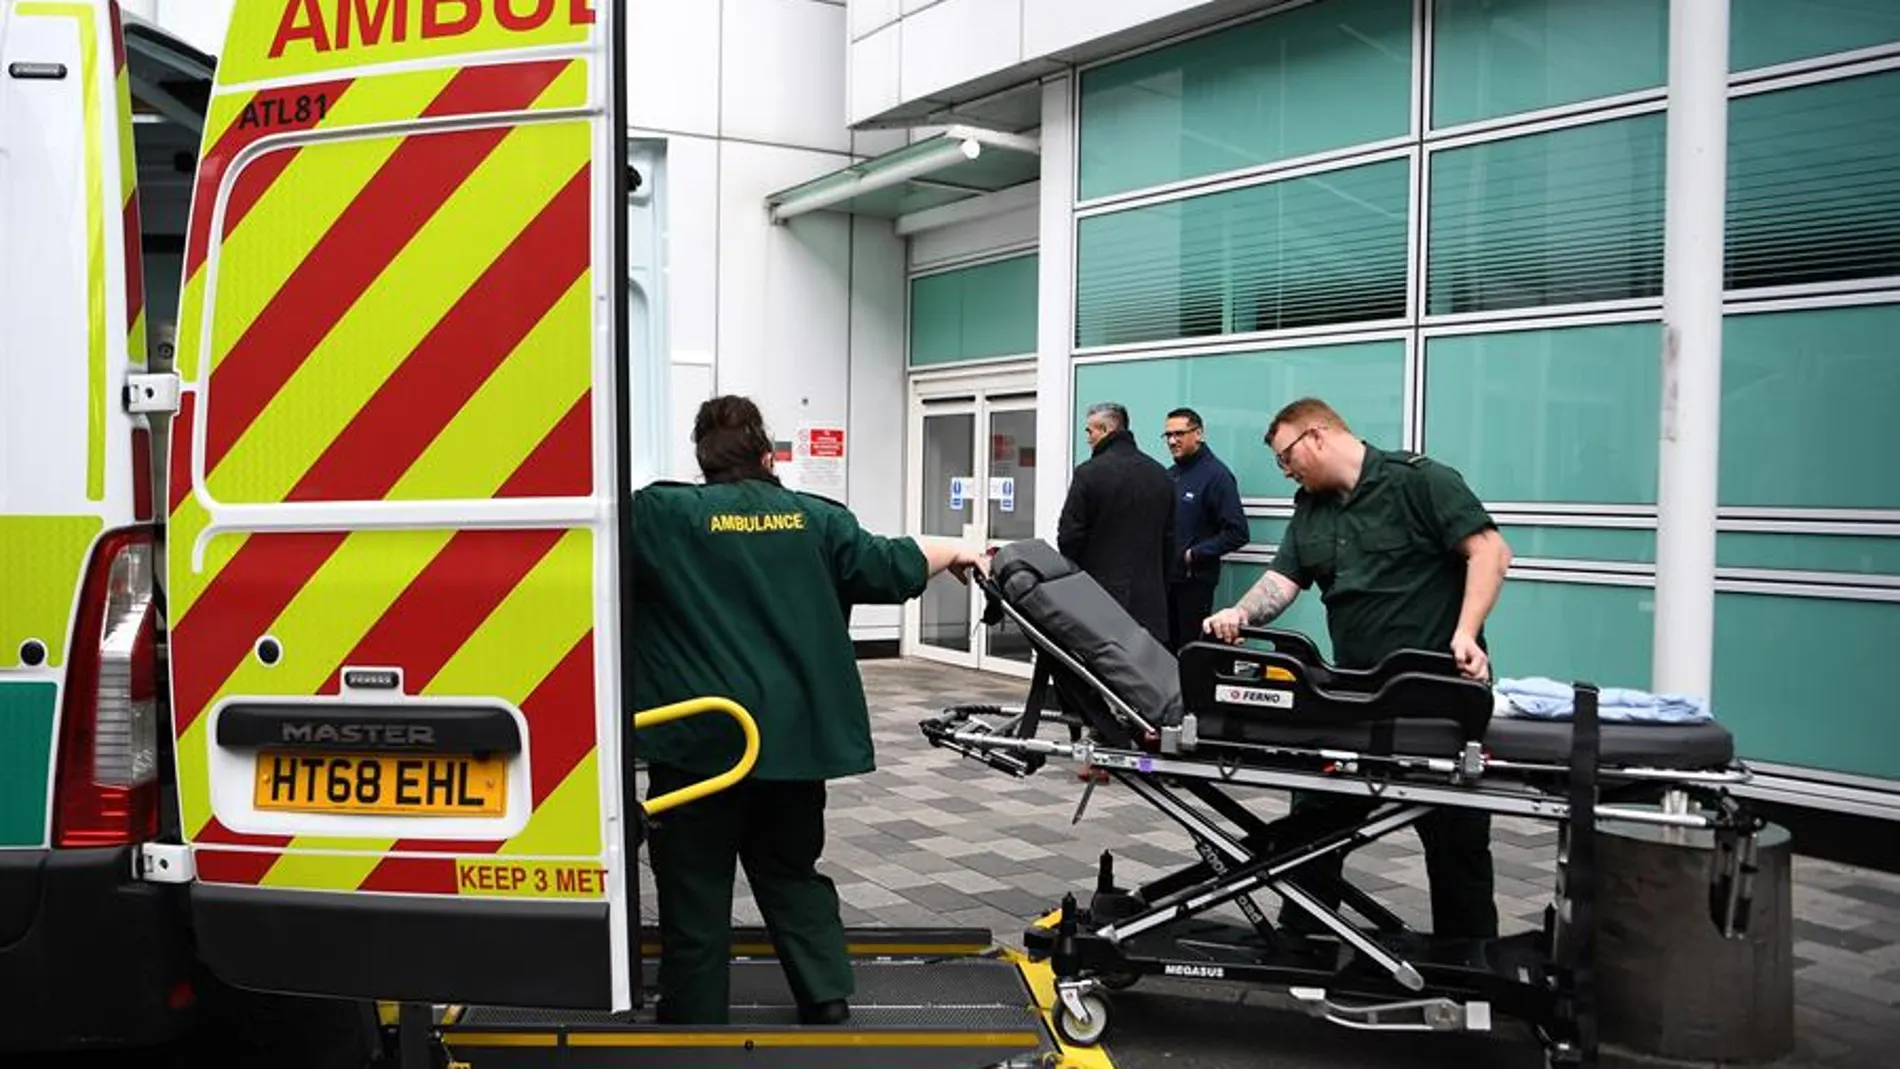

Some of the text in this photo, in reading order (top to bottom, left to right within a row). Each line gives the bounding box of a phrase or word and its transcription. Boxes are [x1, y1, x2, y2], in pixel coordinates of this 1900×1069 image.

[239, 93, 326, 129] ATL81
[710, 512, 805, 533] AMBULANCE
[1243, 691, 1281, 703] FERNO
[282, 722, 436, 744] MASTER
[271, 758, 485, 806] HT68 EHL
[460, 866, 608, 893] KEEP 3 MET
[1164, 965, 1224, 977] MEGASUS
